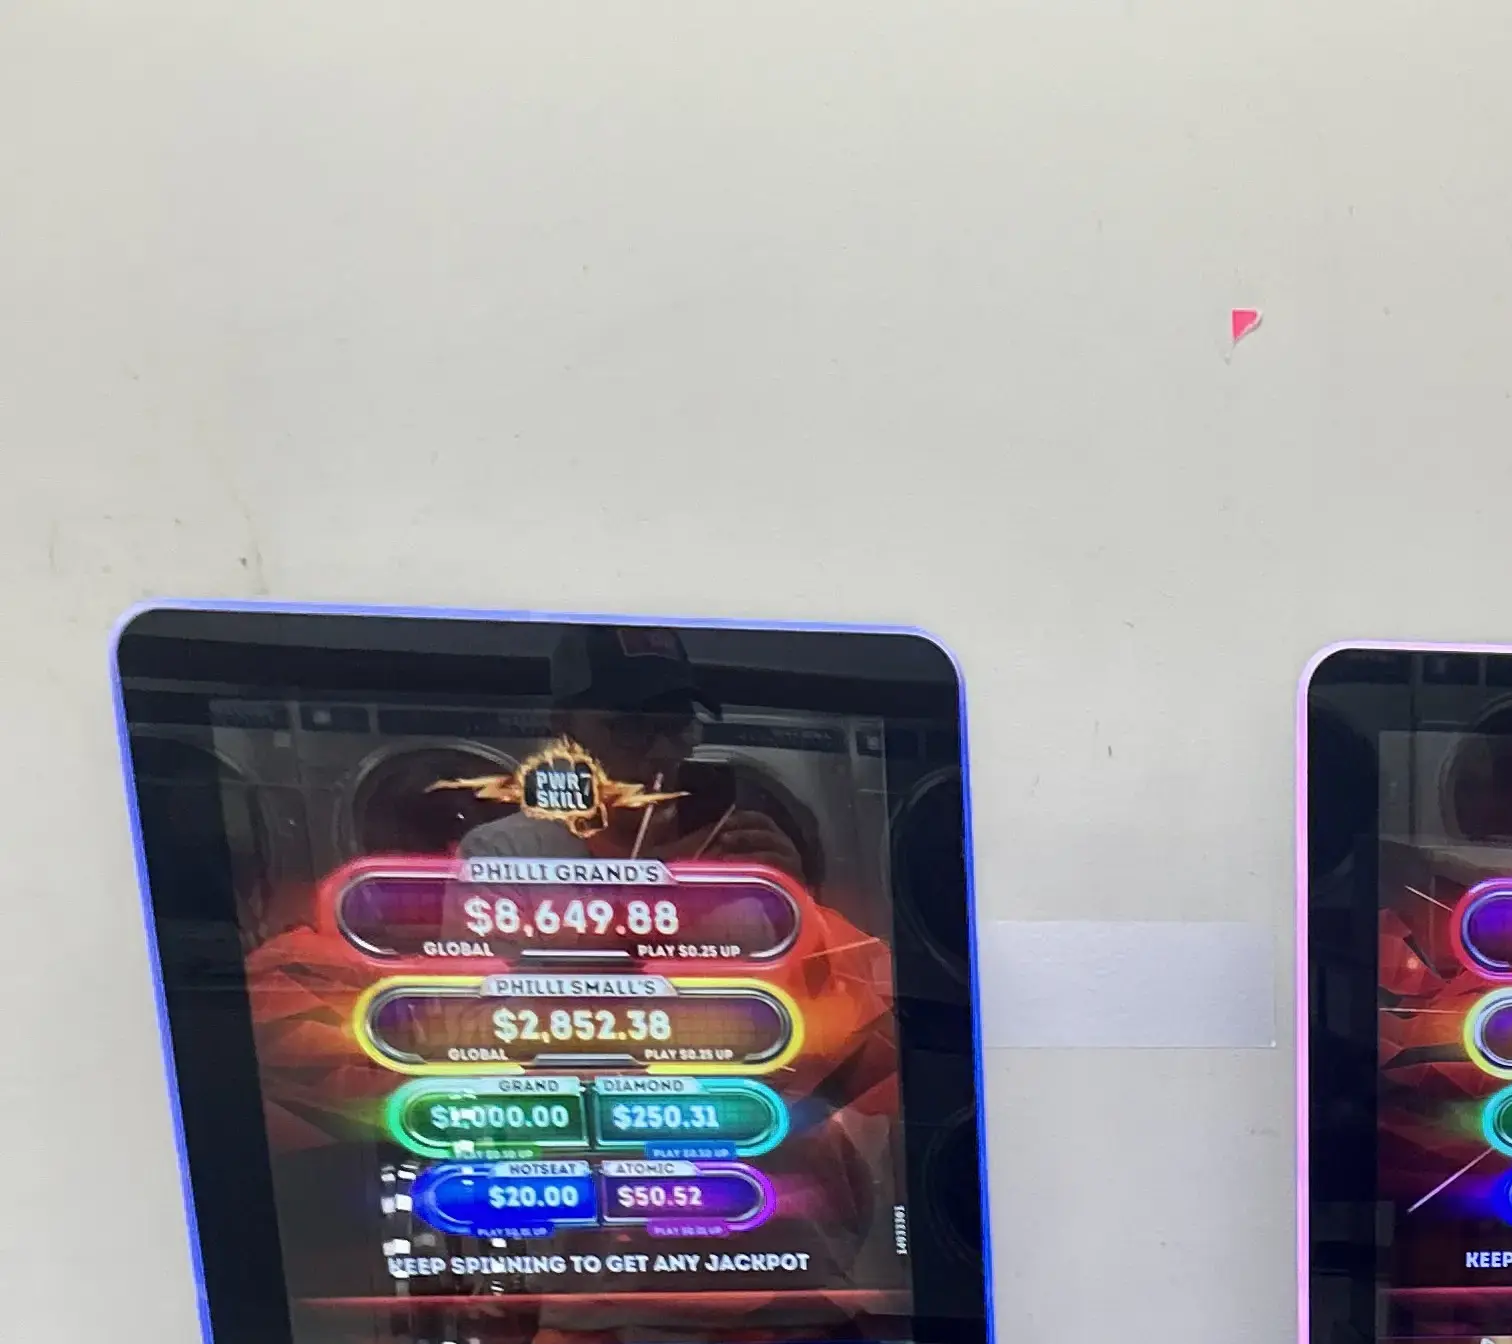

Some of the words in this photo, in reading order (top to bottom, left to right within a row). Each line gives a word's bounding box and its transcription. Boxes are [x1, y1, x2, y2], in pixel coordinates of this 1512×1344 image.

[537, 791, 587, 809] SKILL
[471, 863, 548, 881] PHILLI
[556, 864, 659, 881] GRAND'S
[464, 895, 679, 937] $8,649.88
[423, 941, 494, 957] GLOBAL
[637, 945, 675, 957] PLAY
[678, 944, 718, 957] $0.25
[720, 945, 741, 957] UP
[497, 980, 564, 995] PHILLI
[572, 980, 657, 995] SMALL'S
[492, 1008, 671, 1043] $2,852.38
[448, 1048, 508, 1061] GLOBAL
[644, 1049, 677, 1060] PLAY
[715, 1049, 734, 1060] UP
[499, 1080, 559, 1092] GRAND
[603, 1080, 684, 1092] DIAMOND
[612, 1104, 719, 1131] $250.31
[509, 1163, 576, 1175] HOTSEAT
[616, 1163, 675, 1174] ATOMIC
[489, 1185, 578, 1208] $20.00
[617, 1185, 702, 1207] $50.52
[388, 1257, 446, 1276] KEEP
[451, 1256, 566, 1274] SPINNING
[570, 1255, 601, 1273] TO
[605, 1254, 649, 1273] GET
[653, 1254, 700, 1272] ANY
[704, 1253, 810, 1271] JACKPOT
